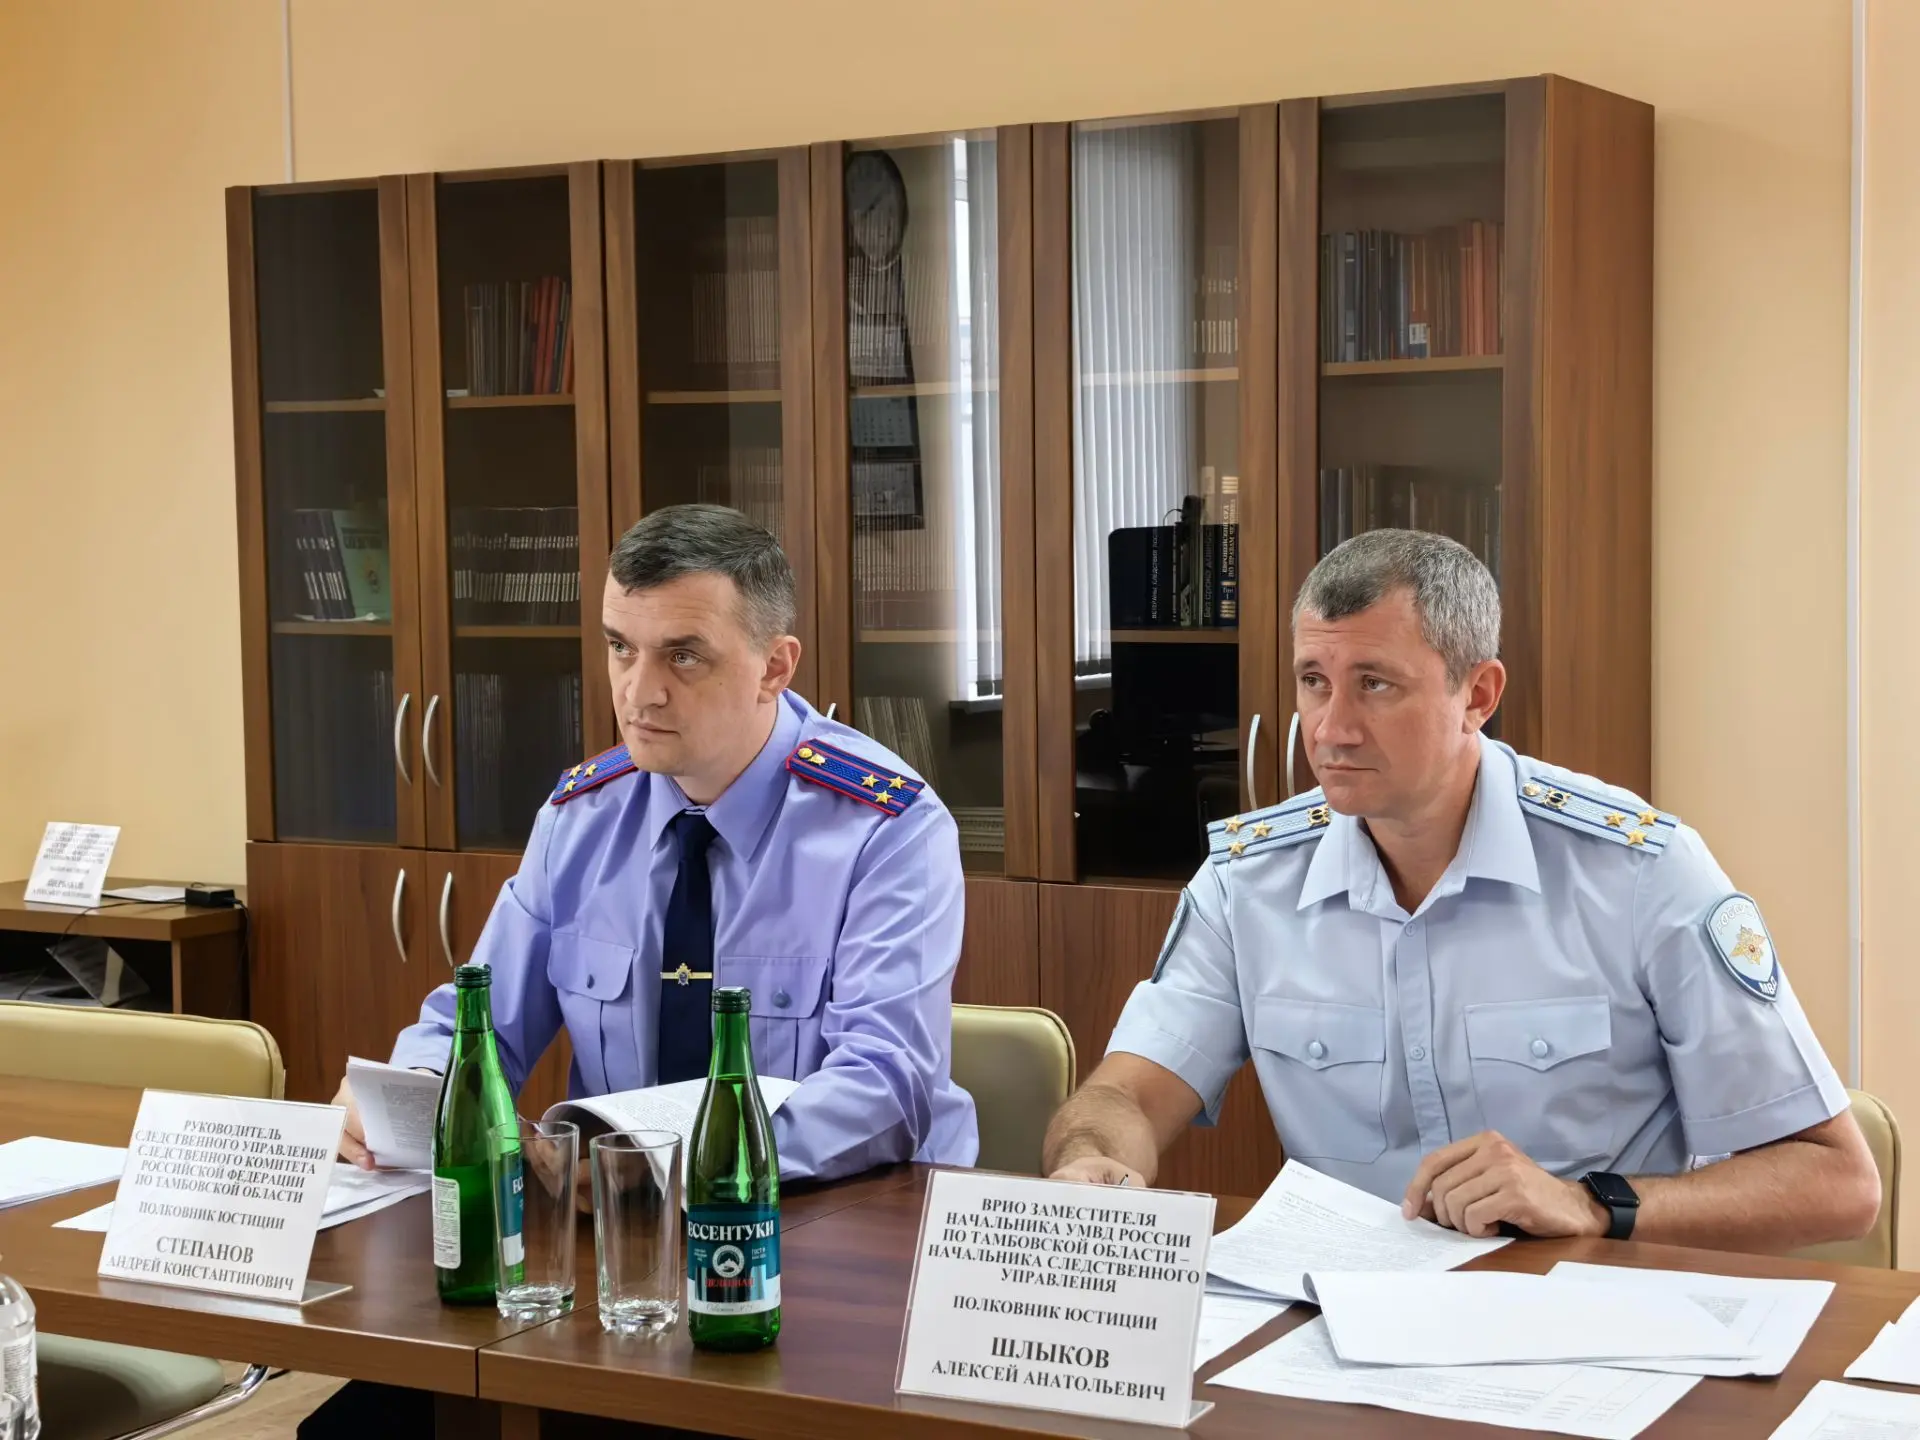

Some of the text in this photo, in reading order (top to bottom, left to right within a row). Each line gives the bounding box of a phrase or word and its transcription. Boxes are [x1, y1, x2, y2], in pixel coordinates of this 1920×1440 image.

[183, 1120, 282, 1140] РУКОВОДИТЕЛЬ
[135, 1130, 328, 1160] СЛЕДСТВЕННОГО УПРАВЛЕНИЯ
[137, 1146, 315, 1175] СЛЕДСТВЕННОГО КОМИТЕТА
[140, 1160, 305, 1188] РОССИЙСКОЙ ФЕДЕРАЦИИ
[135, 1174, 303, 1203] ПО ТАМБОВСКОЙ ОБЛАСТИ
[139, 1201, 285, 1230] ПОЛКОВНИК ЮСТИЦИИ
[981, 1198, 1157, 1227] ВРИО ЗАМЕСТИТЕЛЯ
[688, 1220, 774, 1241] ЕССЕНТУКИ
[946, 1212, 1192, 1248] НАЧАЛЬНИКА УМВД РОССИИ
[156, 1236, 254, 1264] СТЕПАНОВ
[943, 1228, 968, 1243] ПО
[971, 1231, 1088, 1256] ТАМБОВСКОЙ
[1092, 1243, 1176, 1264] ОБЛАСТИ
[107, 1256, 294, 1291] АНДРЕЙ КОНСТАНТИНОВИЧ
[928, 1244, 1200, 1285] НАЧАЛЬНИКА СЛЕДСТВЕННОГО
[1000, 1268, 1117, 1294] УПРАВЛЕНИЯ
[952, 1295, 1158, 1331] ПОЛКОВНИК ЮСТИЦИИ
[991, 1336, 1110, 1369] ШЛЫКОВ
[931, 1360, 1166, 1402] АЛЕКСЕЙ АНАТОЛЬЕВИЧ
